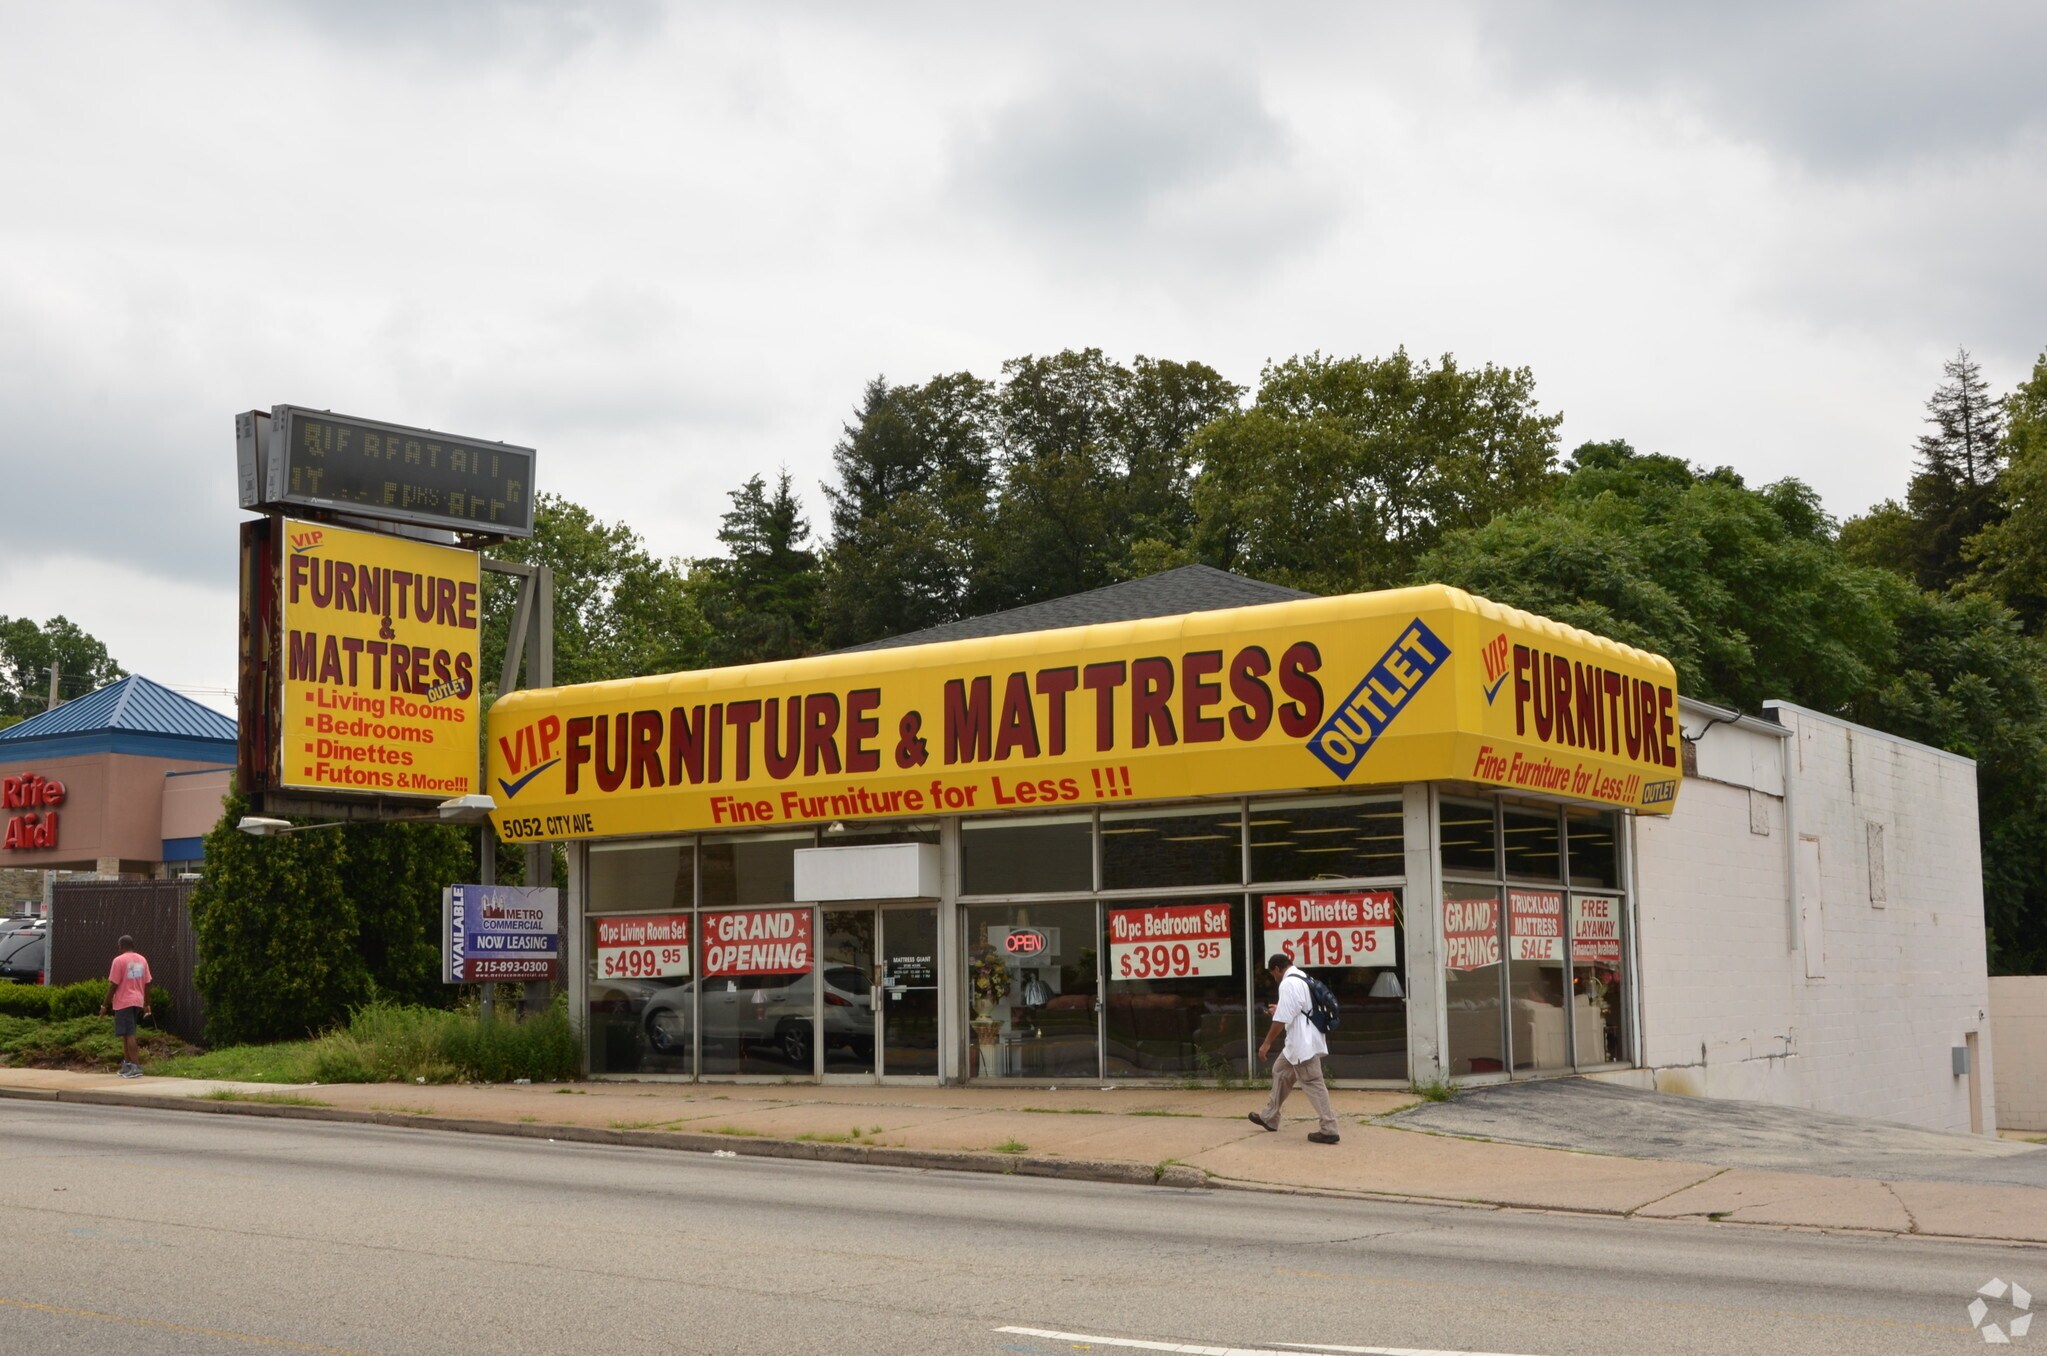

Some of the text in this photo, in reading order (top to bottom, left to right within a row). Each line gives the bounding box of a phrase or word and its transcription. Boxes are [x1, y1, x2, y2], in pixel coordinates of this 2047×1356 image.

[290, 554, 477, 629] FURNITURE
[379, 615, 395, 640] &
[289, 630, 473, 700] MATTRESS
[427, 678, 467, 702] OUTLET
[1320, 627, 1438, 766] OUTLET
[317, 688, 465, 722] Living Rooms
[565, 640, 1325, 795] FURNITURE & MATTRESS
[1513, 643, 1677, 768] FURNITURE
[317, 713, 434, 743] Bedrooms
[316, 738, 413, 766] Dinettes
[316, 762, 394, 787] Futons
[397, 772, 410, 788] &
[1473, 745, 1507, 782] Fine
[1507, 751, 1570, 791] Furniture
[1571, 763, 1592, 795] for
[1592, 768, 1624, 801] Less
[1, 772, 66, 809] Rite
[710, 796, 774, 824] Fine
[779, 786, 924, 820] Furniture
[929, 780, 978, 809] for
[991, 776, 1080, 805] Less
[1643, 782, 1675, 804] OUTLET
[2, 811, 59, 849] Aid
[502, 813, 594, 838] 5052 CITY AVE
[506, 909, 543, 919] METRO
[1300, 899, 1358, 922] Dinette
[1362, 897, 1390, 920] Set
[1445, 902, 1491, 933] GRAND
[1511, 894, 1560, 915] TRUCKLOAD
[1581, 899, 1609, 917] FREE
[452, 887, 464, 979] AVAILABLE
[483, 920, 543, 930] COMMERCIAL
[620, 922, 645, 945] Living
[647, 921, 670, 940] Room
[671, 920, 686, 939] Set
[718, 912, 795, 942] GRAND
[1144, 912, 1201, 936] Bedroom
[1204, 909, 1227, 933] Set
[1514, 917, 1557, 936] MATTRESS
[1576, 919, 1615, 937] LAYAWAY
[476, 936, 547, 949] NOW LEASING
[1005, 934, 1042, 951] OPEN
[1521, 939, 1552, 959] SALE
[1573, 940, 1619, 959] Financing Available
[475, 961, 548, 972] 215-893-0300
[706, 942, 807, 972] OPENING
